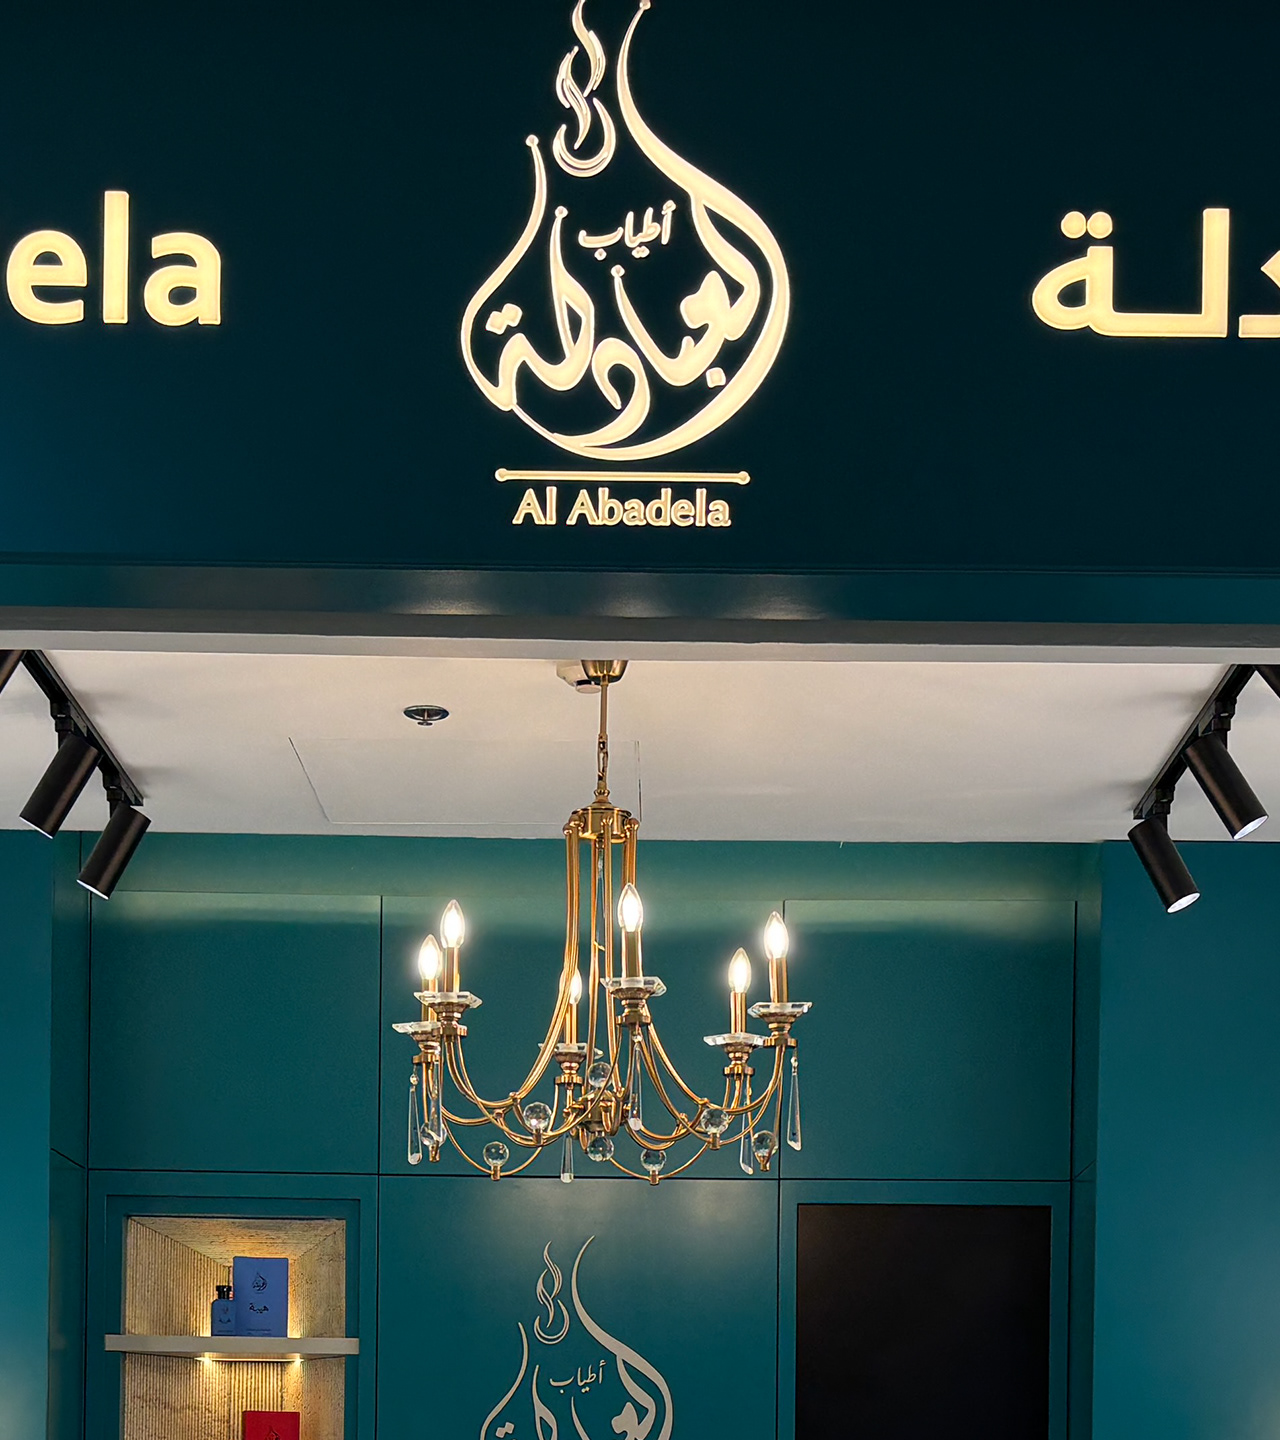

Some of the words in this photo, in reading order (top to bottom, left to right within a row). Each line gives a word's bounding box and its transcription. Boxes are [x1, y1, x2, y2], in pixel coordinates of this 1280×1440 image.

[577, 200, 677, 261] أطياب
[512, 486, 558, 526] Al
[565, 486, 733, 527] Abadela
[549, 1359, 607, 1393] أطياب
